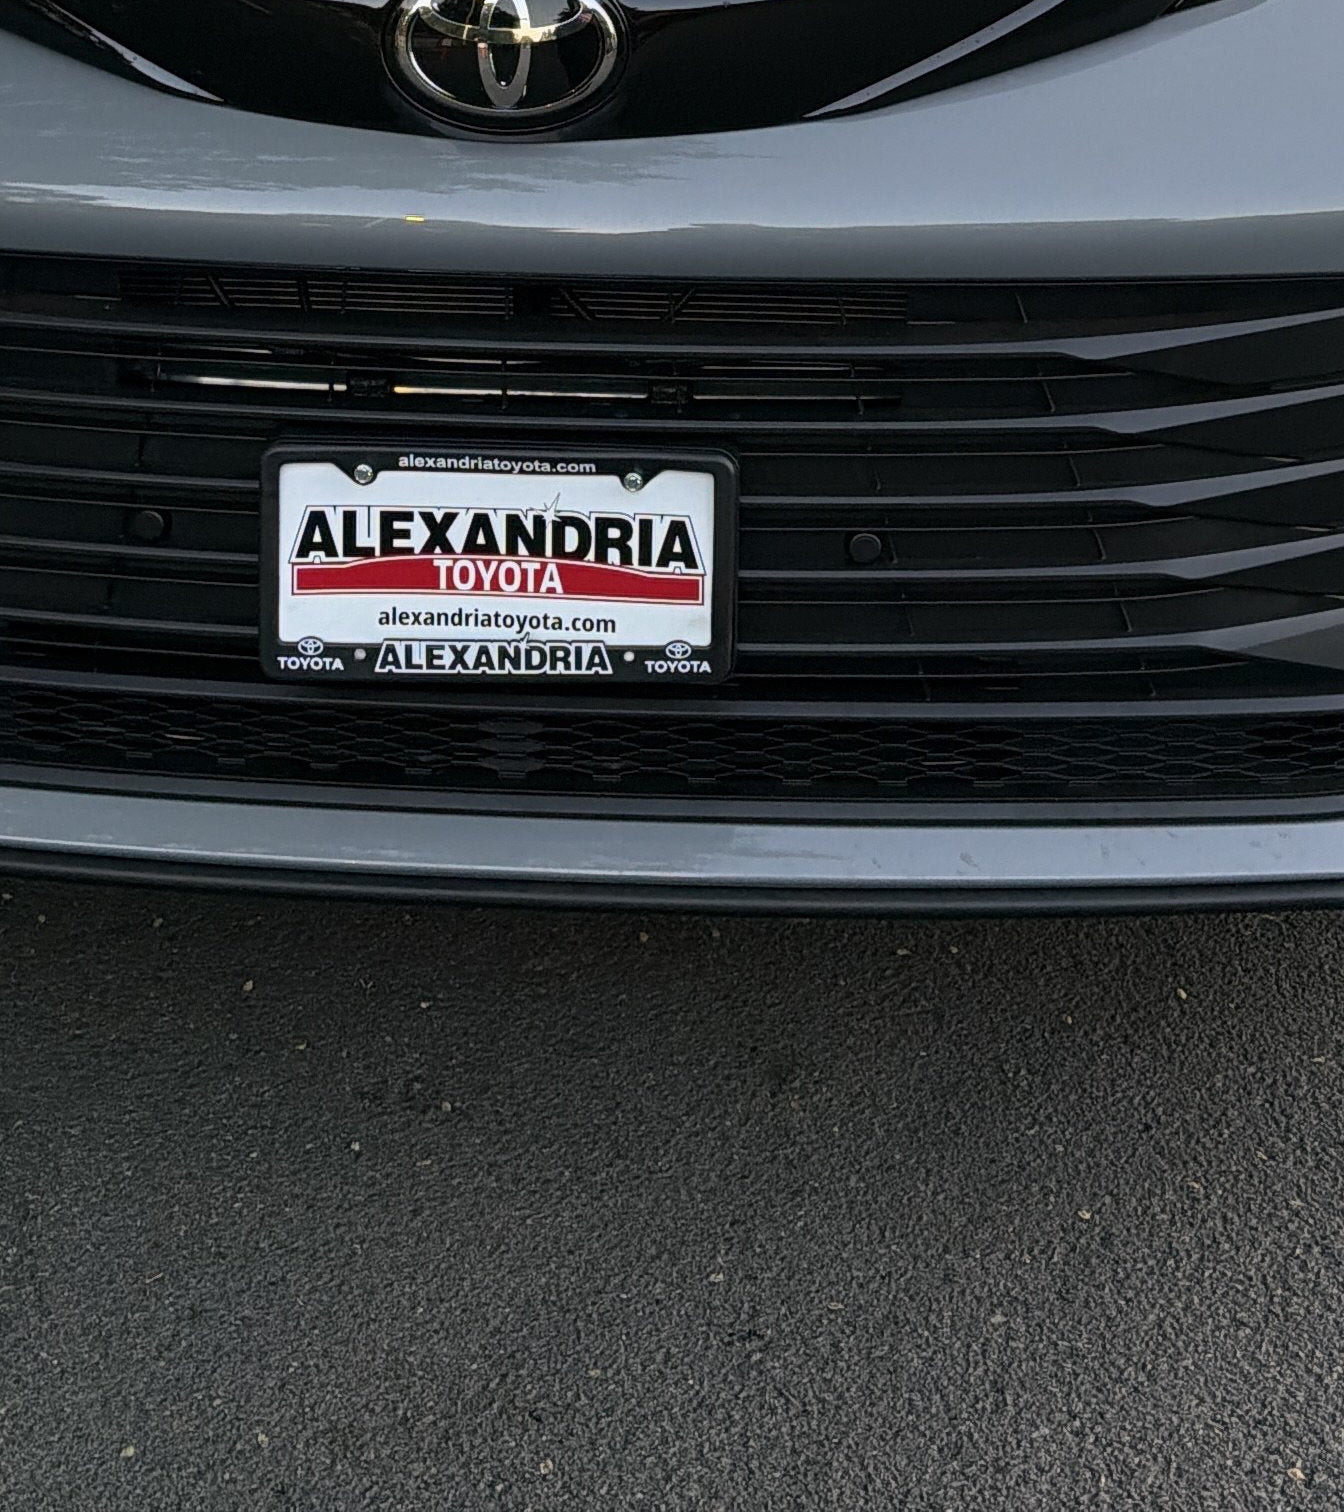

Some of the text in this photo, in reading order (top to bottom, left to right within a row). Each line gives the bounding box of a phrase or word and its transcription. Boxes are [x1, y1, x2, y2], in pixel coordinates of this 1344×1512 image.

[398, 454, 596, 474] alexandriatoyota.com
[291, 506, 705, 574] ALEXANDRIA
[433, 559, 564, 594] TOYOTA
[377, 607, 617, 634] alexandriatoyota.com
[277, 656, 344, 671] TOYOTA
[374, 638, 613, 675] ALEXANDRIA
[645, 659, 712, 674] TOYOTA
